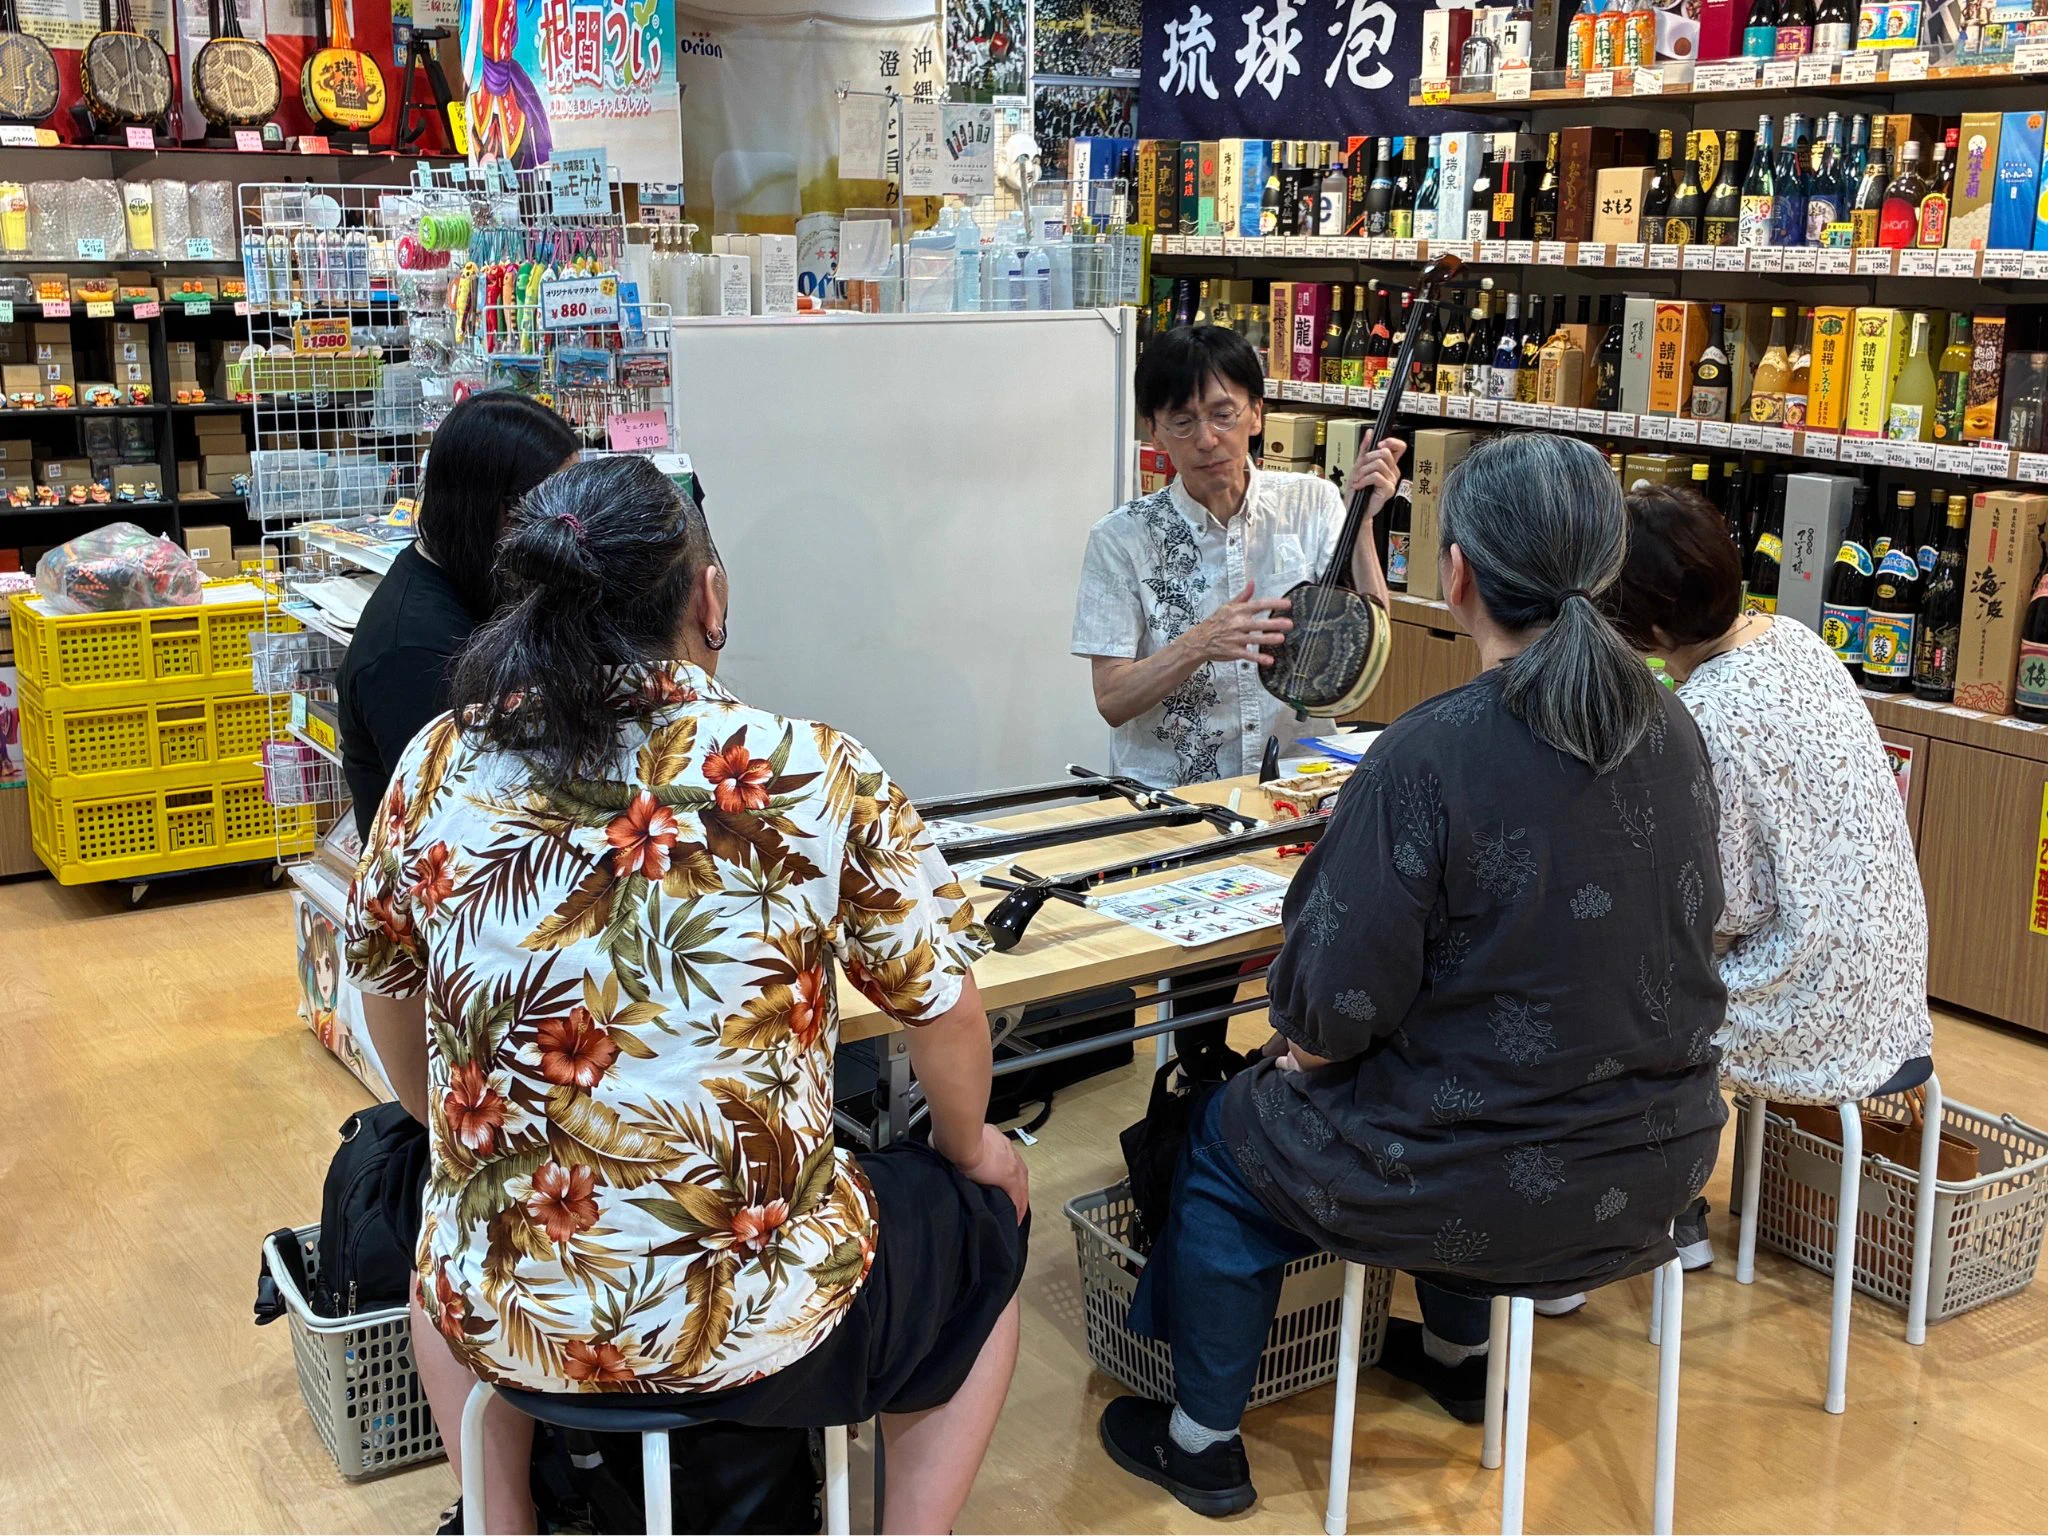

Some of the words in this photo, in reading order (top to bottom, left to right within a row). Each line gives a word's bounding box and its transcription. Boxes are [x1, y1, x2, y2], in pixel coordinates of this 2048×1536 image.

[681, 38, 723, 59] Orion
[1159, 0, 1476, 100] 琉球泡
[1445, 156, 1458, 193] 瑞泉
[1601, 197, 1633, 215] おもろ
[546, 286, 599, 298] オリジナルマグネット
[1295, 317, 1312, 347] 龍
[1656, 341, 1676, 380] 請福
[1418, 459, 1434, 496] 瑞泉
[1970, 564, 2006, 624] 海波
[2023, 662, 2048, 687] 梅
